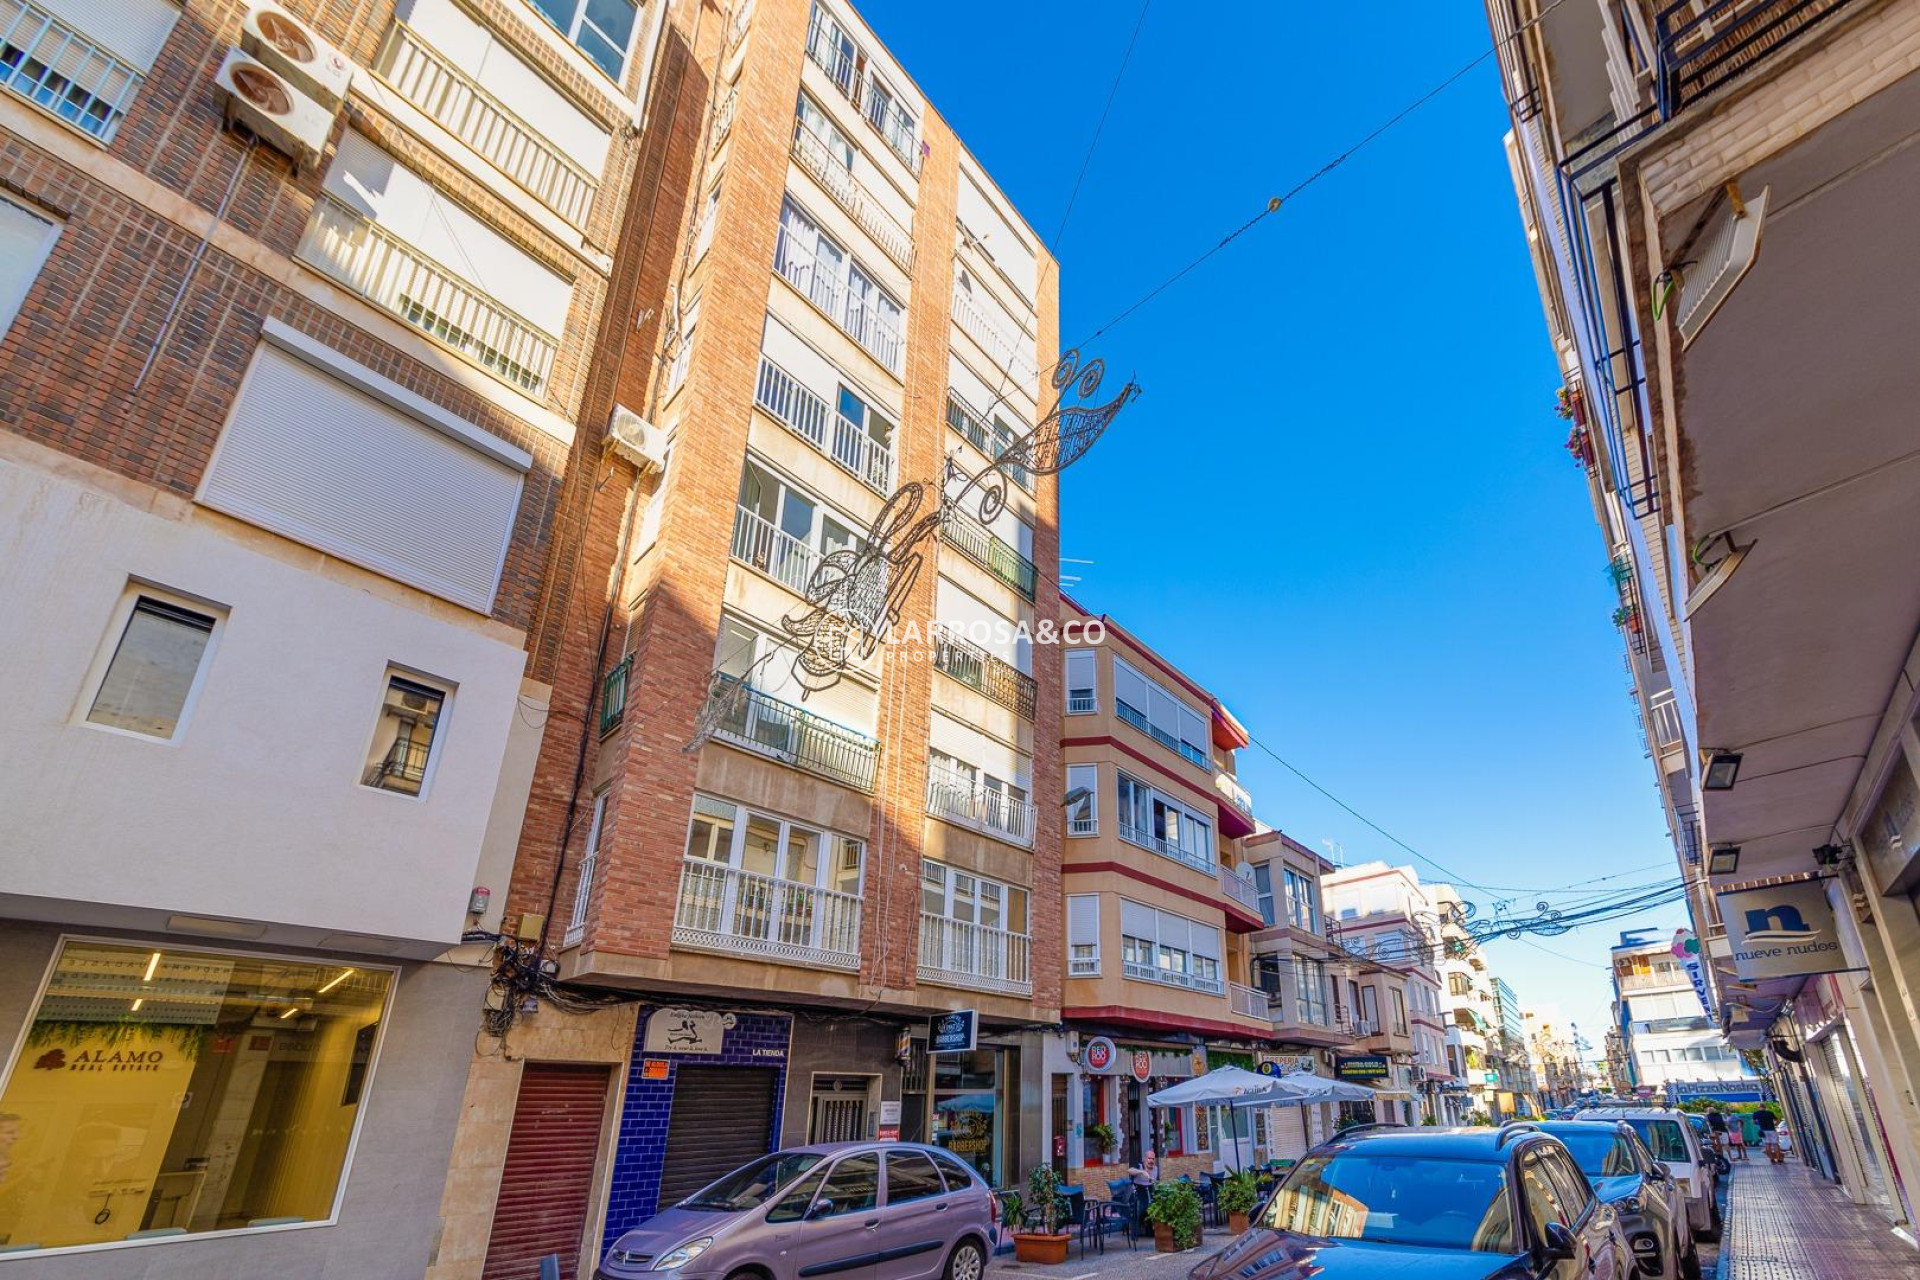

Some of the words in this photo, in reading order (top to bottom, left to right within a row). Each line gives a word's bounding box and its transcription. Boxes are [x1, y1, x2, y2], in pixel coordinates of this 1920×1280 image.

[1735, 947, 1782, 961] nueve
[1786, 941, 1838, 956] nudos
[74, 1050, 164, 1063] ALAMO
[763, 1049, 785, 1057] TIENDA
[69, 1063, 103, 1071] REAL
[112, 1064, 160, 1072] ESTATE
